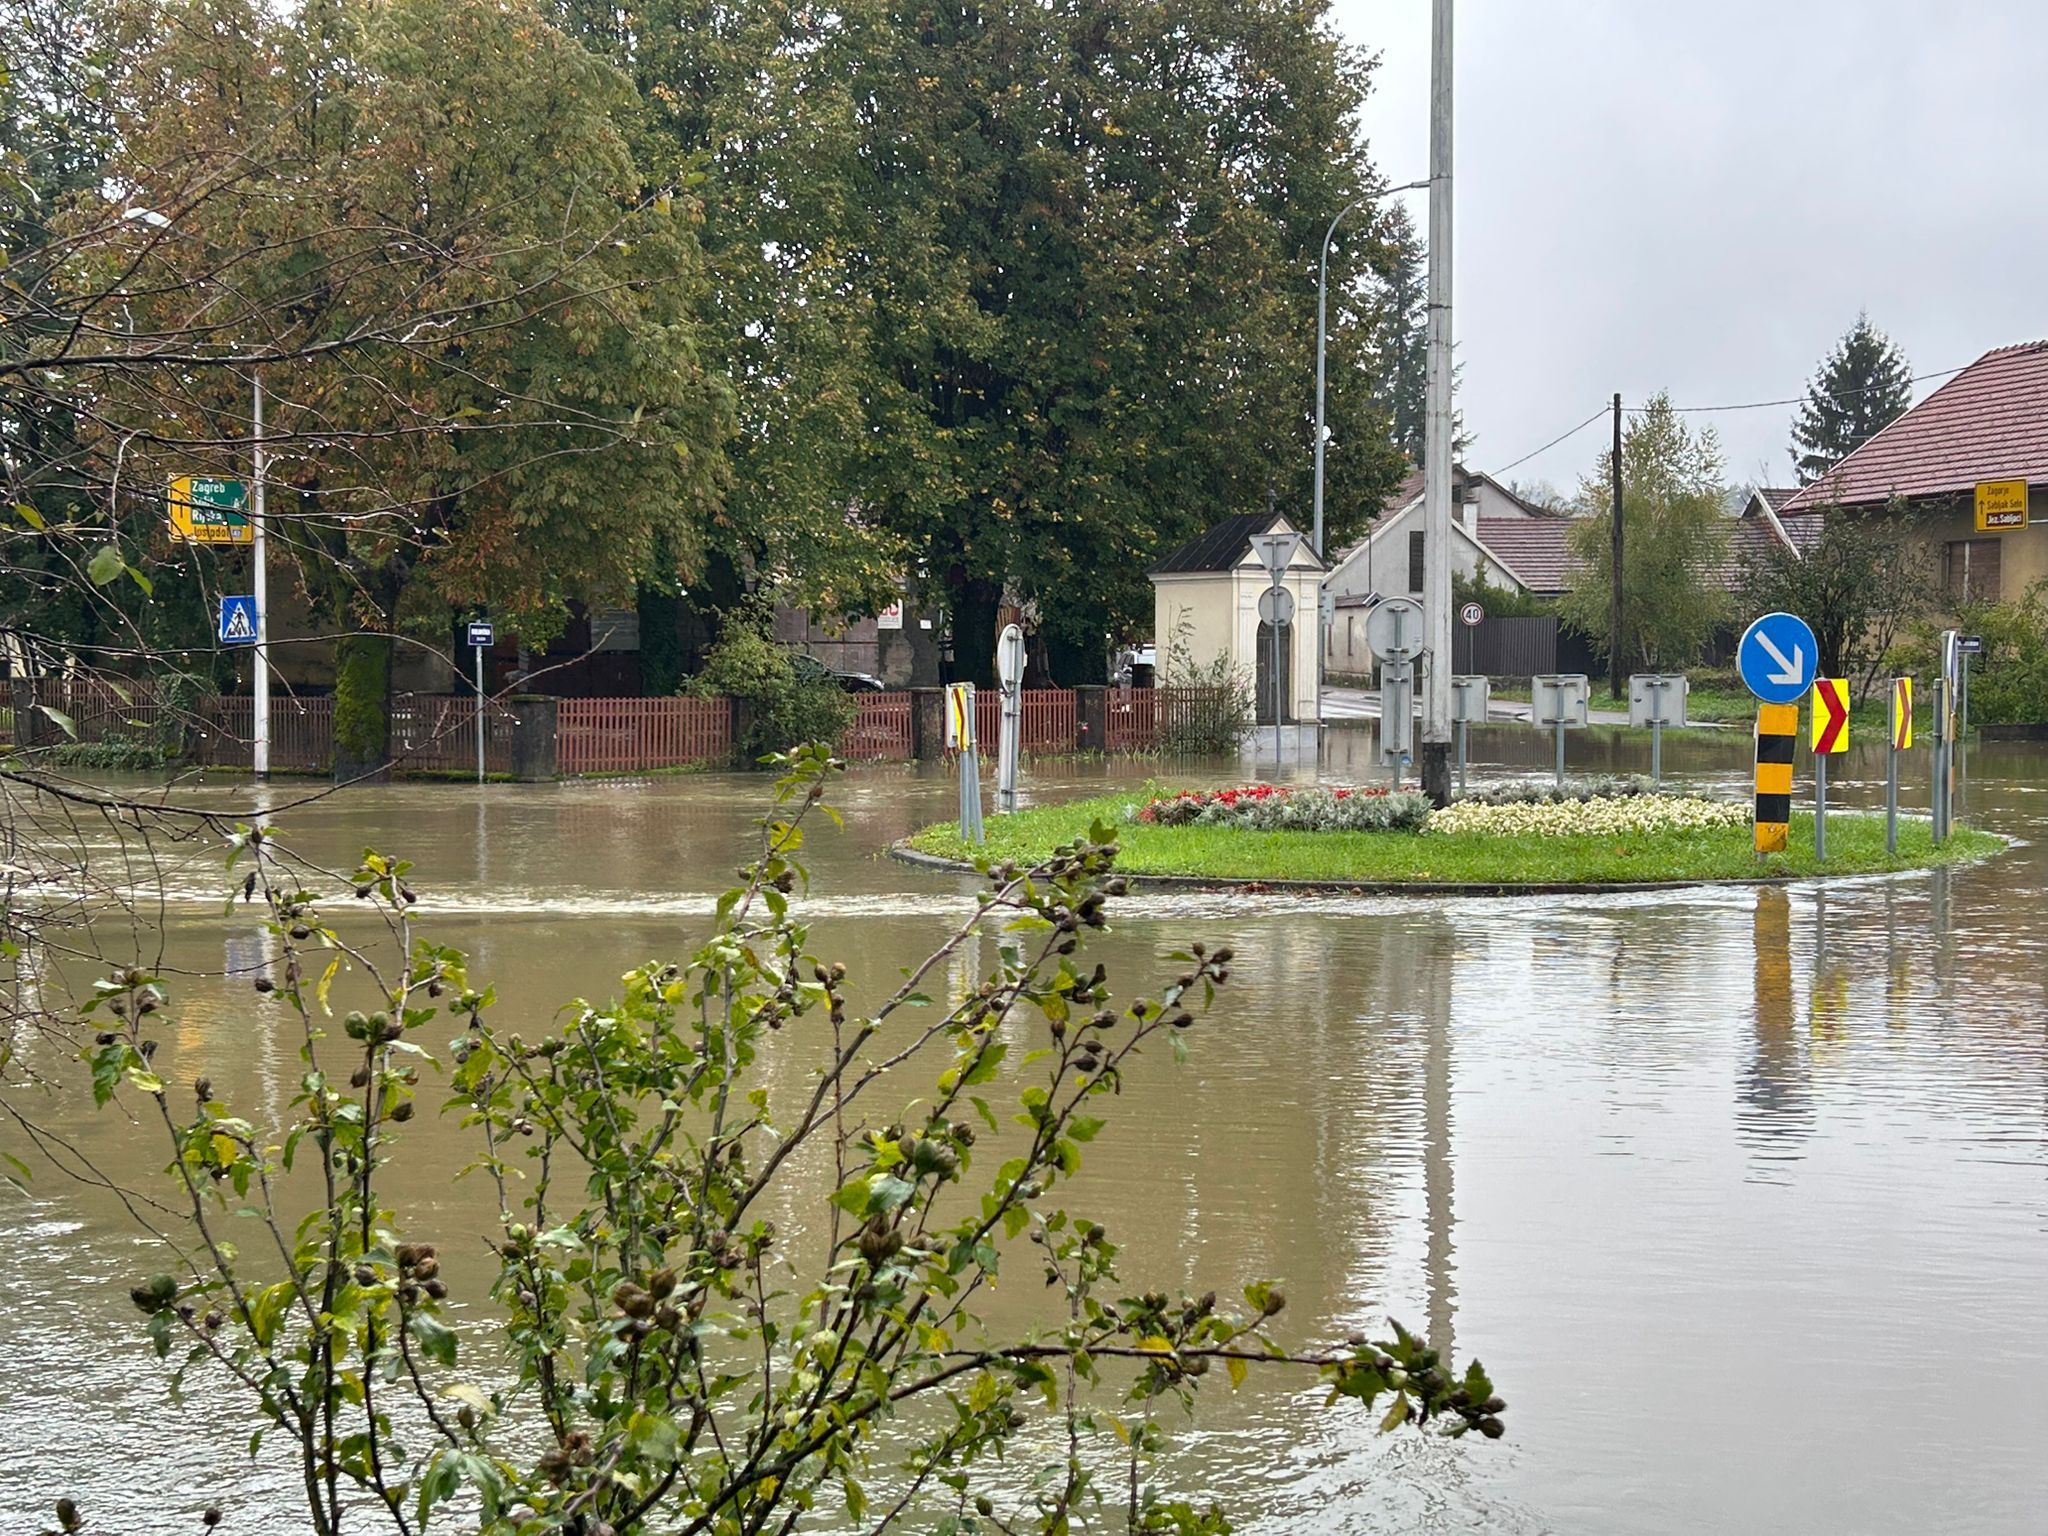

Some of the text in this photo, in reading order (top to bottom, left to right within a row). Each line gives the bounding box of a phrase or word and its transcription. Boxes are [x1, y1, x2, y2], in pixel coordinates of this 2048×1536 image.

[192, 480, 226, 495] Zagreb
[1987, 486, 2009, 497] Zagorje
[1465, 608, 1479, 620] 40
